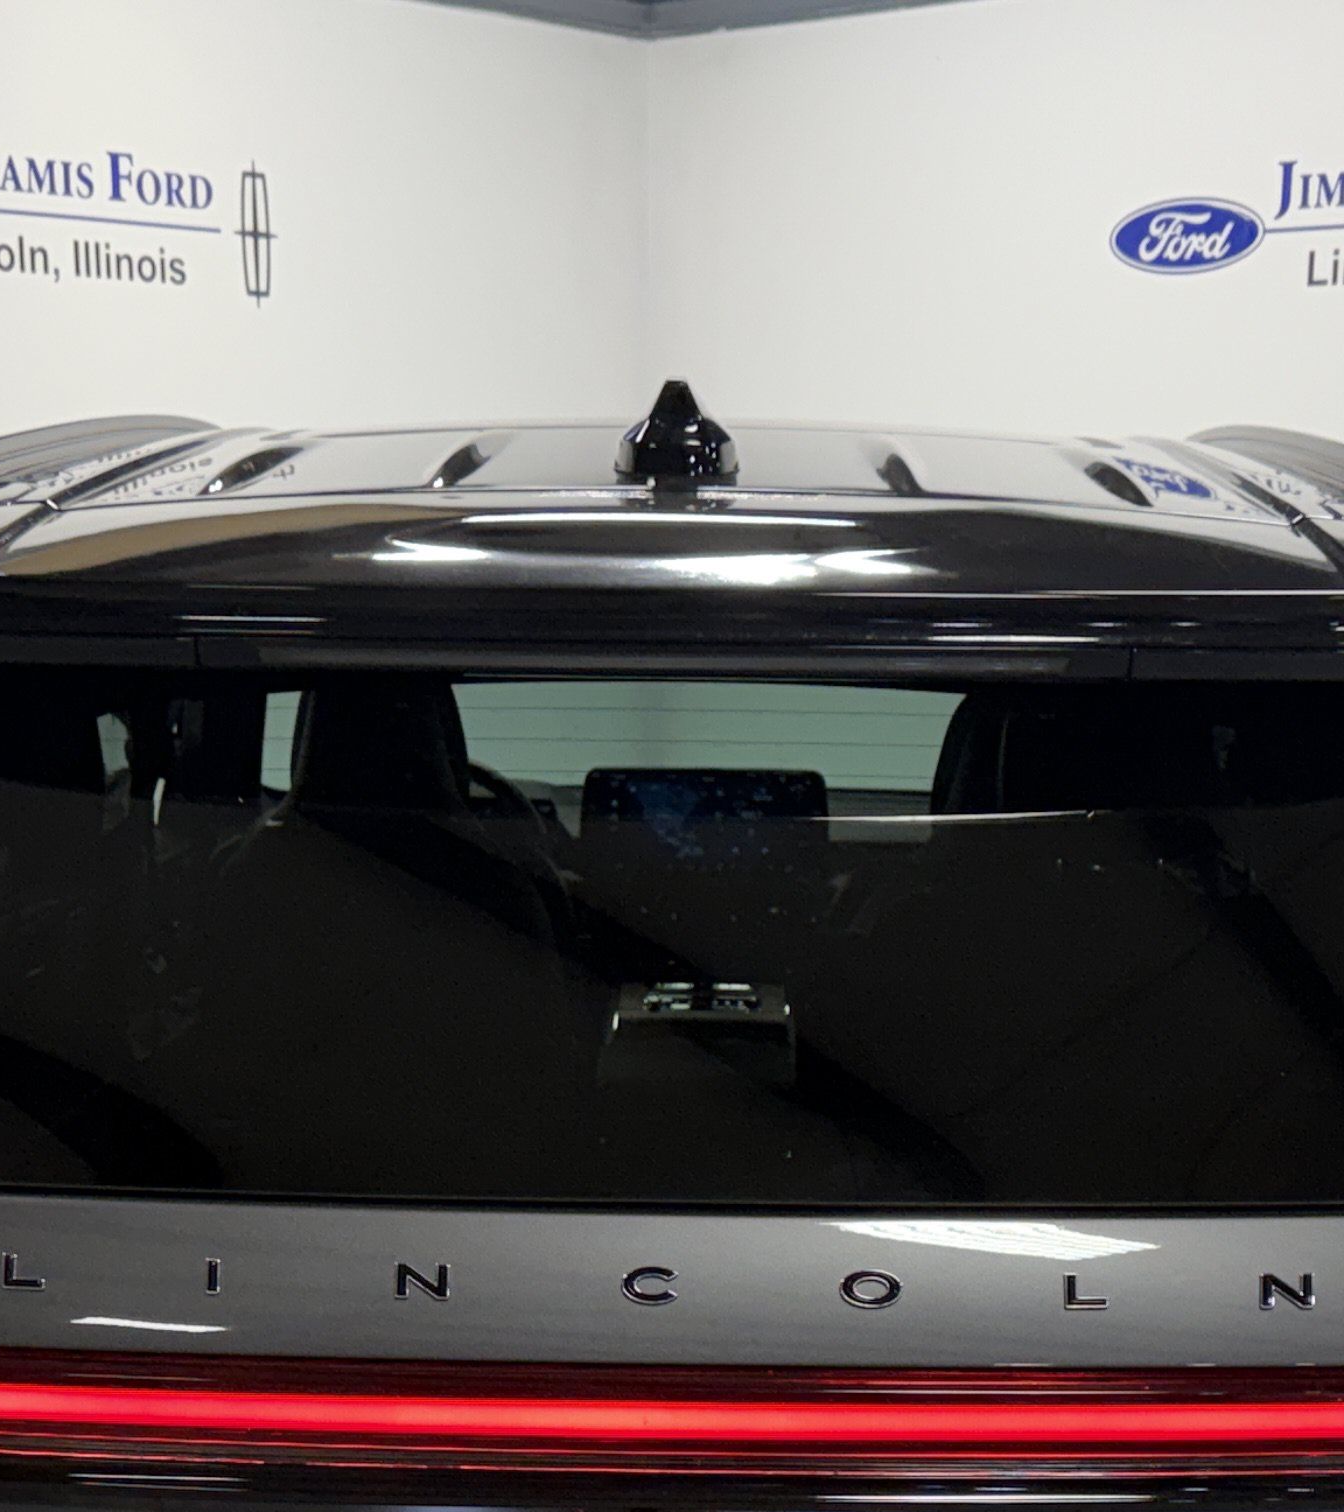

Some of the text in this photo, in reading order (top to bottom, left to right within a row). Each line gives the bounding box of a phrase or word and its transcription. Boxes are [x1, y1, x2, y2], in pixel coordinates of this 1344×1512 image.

[106, 150, 214, 211] FORD
[73, 239, 187, 286] Illinois
[1138, 211, 1232, 262] Ford
[0, 1250, 1318, 1311] LINCOLN
